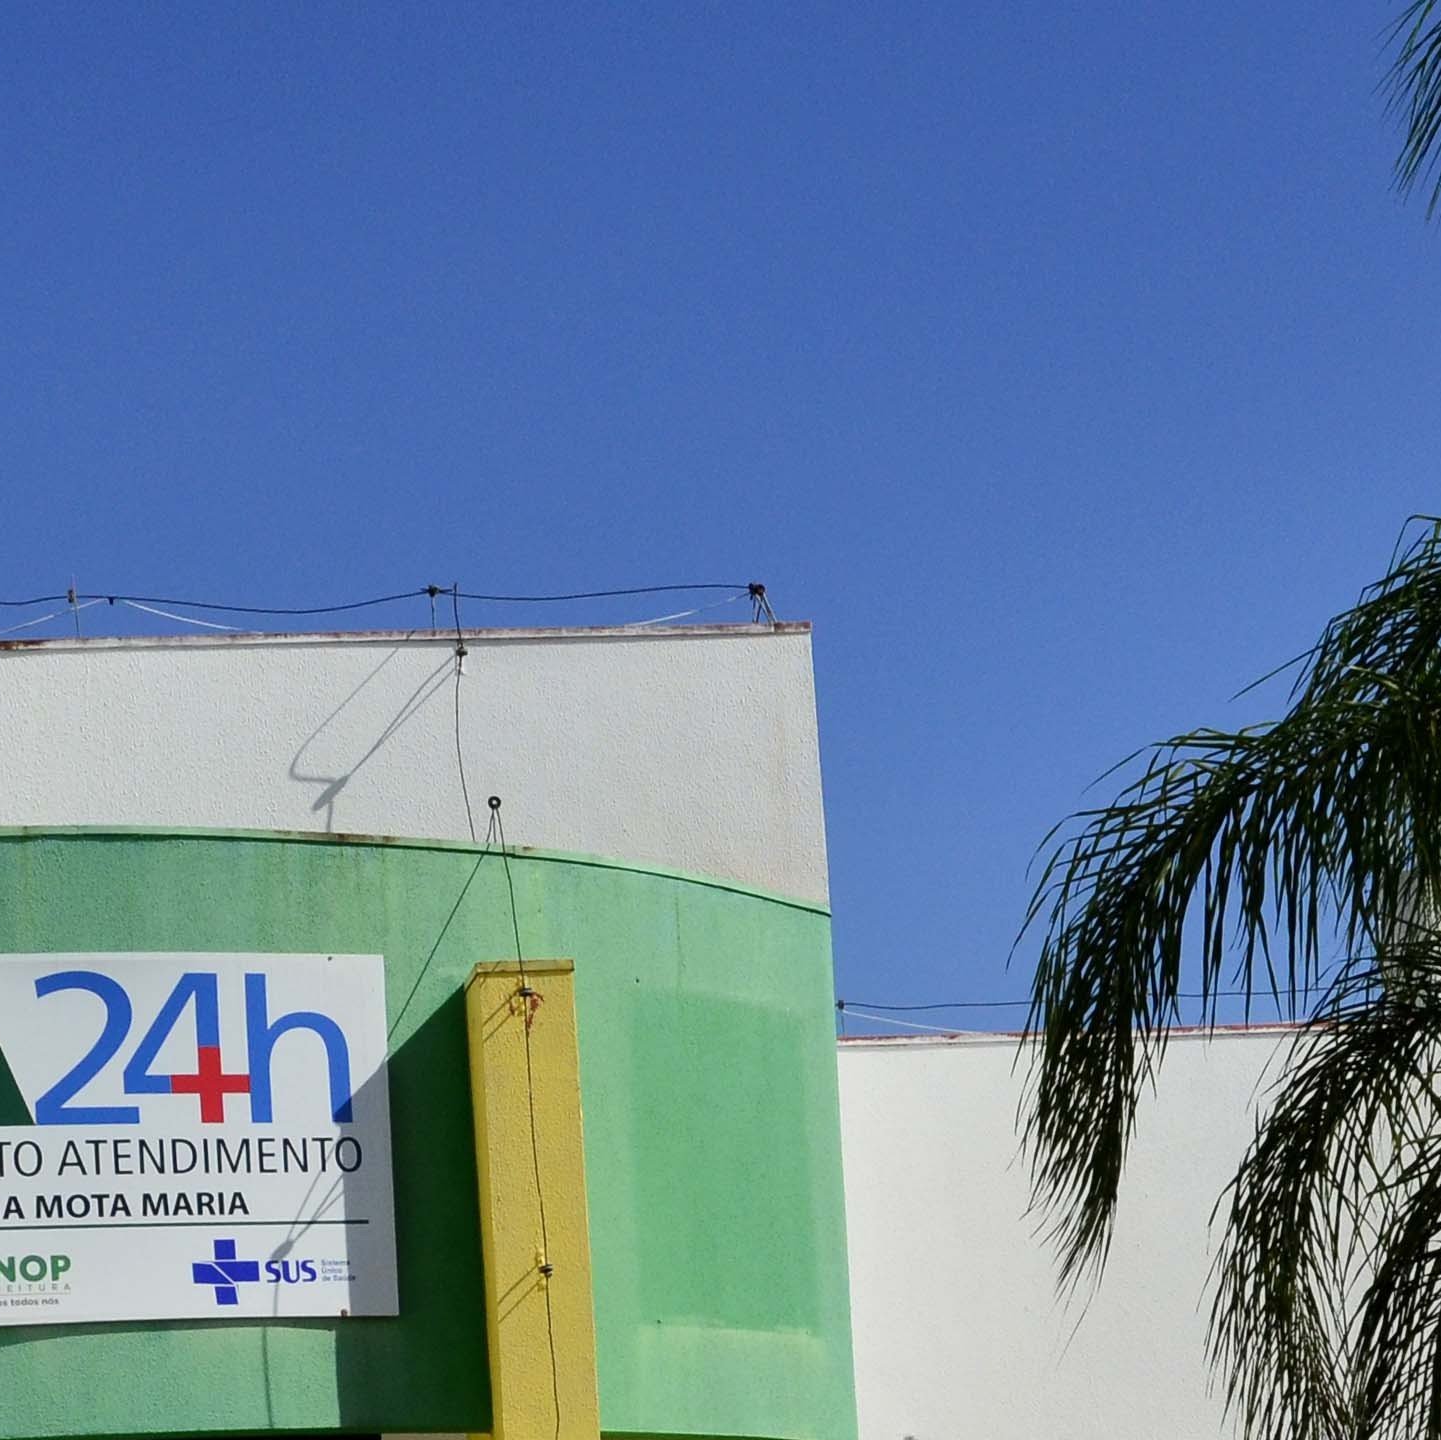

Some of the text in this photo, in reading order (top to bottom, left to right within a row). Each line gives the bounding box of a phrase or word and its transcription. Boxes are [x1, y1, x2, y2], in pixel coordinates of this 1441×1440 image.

[35, 970, 353, 1125] 24h
[58, 1136, 363, 1176] ATENDIMENTO
[35, 1194, 132, 1219] MOTA
[142, 1191, 250, 1217] MARIA
[264, 1259, 317, 1284] SUS
[10, 1298, 39, 1307] todos
